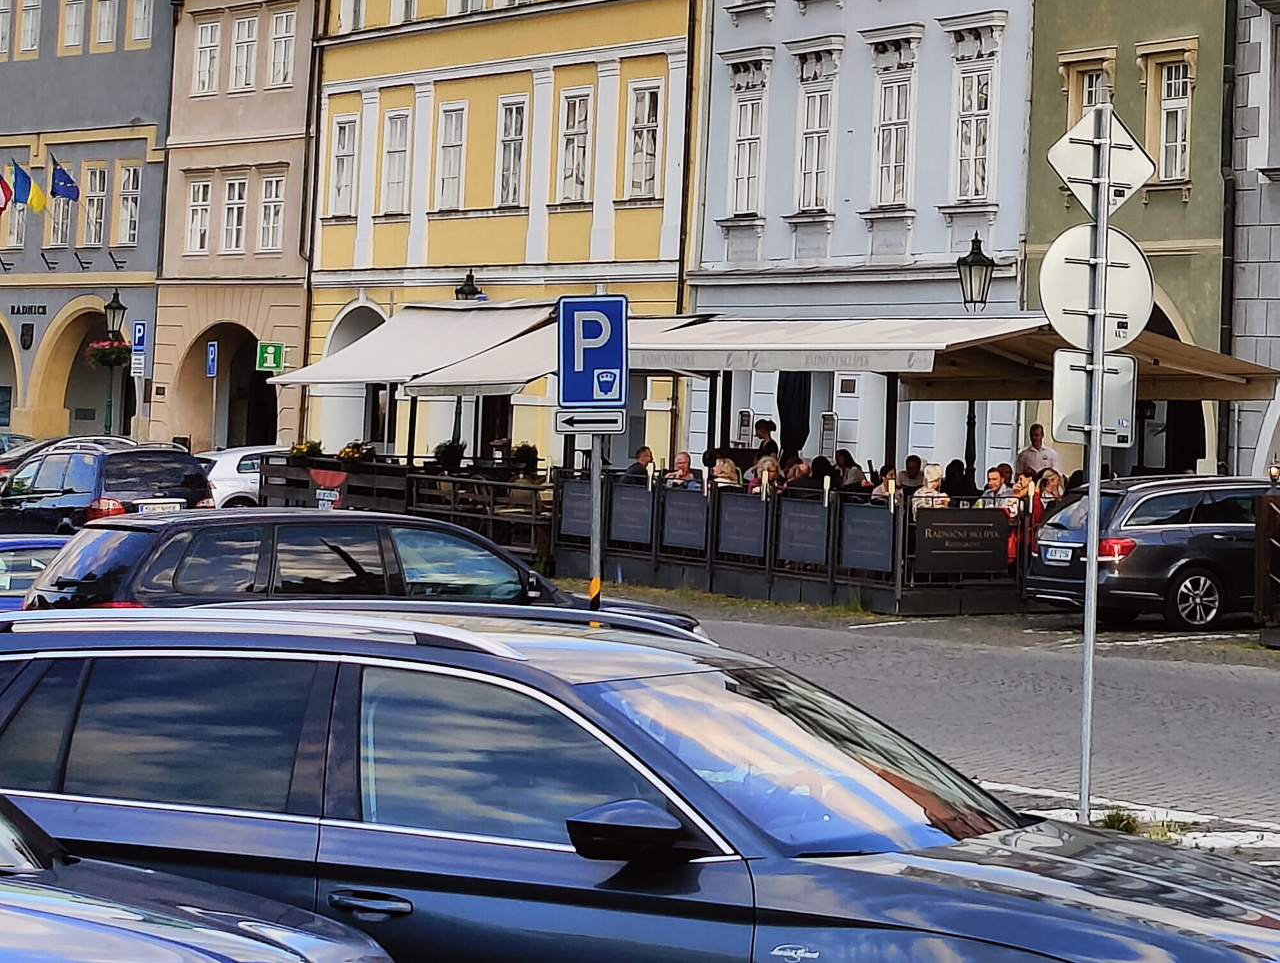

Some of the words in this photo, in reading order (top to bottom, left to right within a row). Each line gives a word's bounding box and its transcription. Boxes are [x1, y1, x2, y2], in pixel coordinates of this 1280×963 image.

[10, 305, 47, 315] RADNICE
[135, 324, 144, 345] P
[573, 310, 612, 372] P
